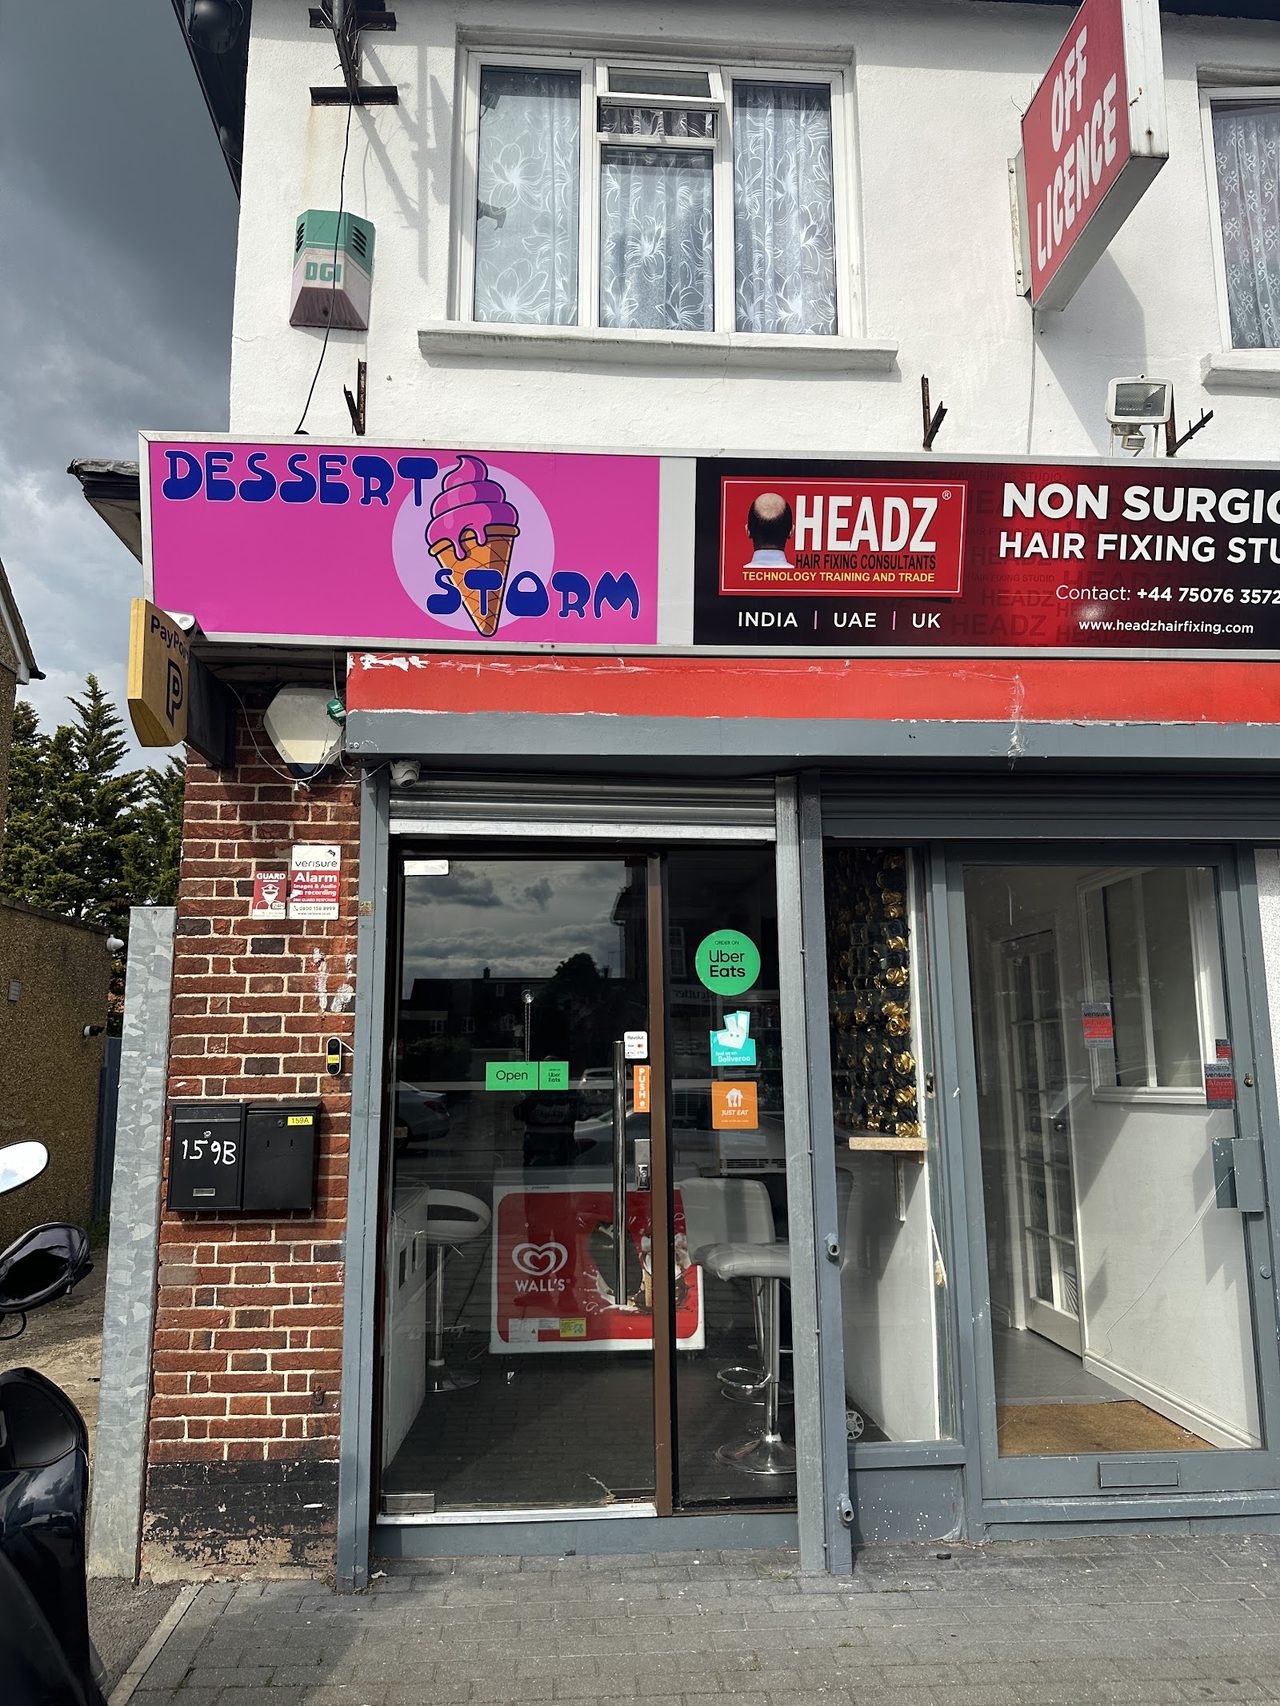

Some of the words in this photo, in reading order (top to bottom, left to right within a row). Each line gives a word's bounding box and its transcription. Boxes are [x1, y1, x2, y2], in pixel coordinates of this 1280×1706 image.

[1051, 25, 1088, 153] OFF
[1036, 72, 1118, 272] LICENCE
[162, 450, 439, 507] DESSERT
[1002, 482, 1109, 520] NON
[794, 495, 938, 553] HEADZ
[999, 531, 1085, 560] HAIR
[1097, 534, 1215, 563] FIXING
[795, 554, 820, 569] HAIR
[823, 554, 858, 569] FIXING
[860, 555, 936, 570] CONSULTANTS
[742, 571, 817, 582] TECHNOLOGY
[819, 572, 870, 582] TRAINING
[873, 572, 895, 582] AND
[898, 573, 935, 583] TRADE
[426, 568, 640, 620] STORM
[1055, 585, 1131, 602] Contact:
[1136, 587, 1173, 602] +44
[1178, 588, 1234, 604] 75076
[1239, 588, 1280, 605] 3572
[738, 611, 798, 628] INDIA
[833, 612, 877, 628] UAE
[912, 613, 941, 629] UK
[1078, 619, 1255, 636] www.headzhairfixing.com
[295, 860, 337, 868] verisure
[294, 872, 337, 882] Alarm
[304, 889, 337, 897] recording
[709, 949, 745, 963] Uber
[709, 964, 746, 978] Eats
[717, 1055, 751, 1064] Deliveroo
[496, 1070, 528, 1082] Open
[638, 1067, 646, 1099] PUSH
[720, 1109, 737, 1117] JUST
[736, 1109, 750, 1117] EAT
[181, 1138, 237, 1166] 159B
[514, 1278, 566, 1293] WALL'S
